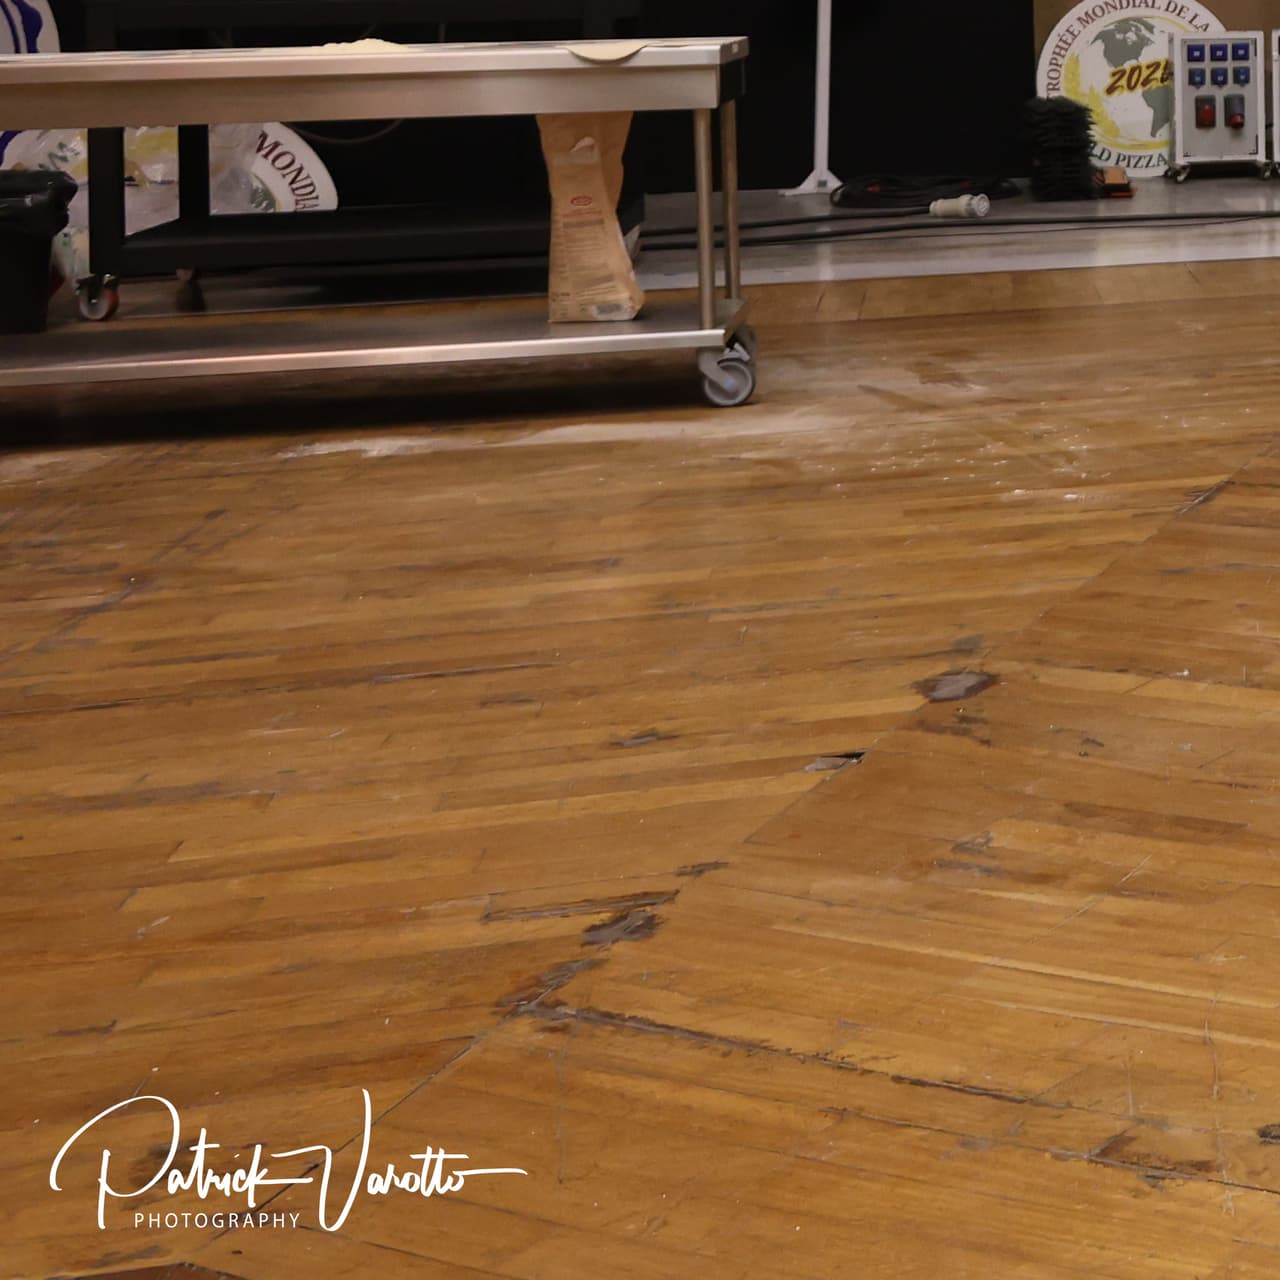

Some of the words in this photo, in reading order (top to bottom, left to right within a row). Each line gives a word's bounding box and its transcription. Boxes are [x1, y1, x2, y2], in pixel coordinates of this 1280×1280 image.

[1164, 0, 1190, 20] DE
[1188, 13, 1211, 33] LA
[1114, 152, 1168, 170] PIZZA
